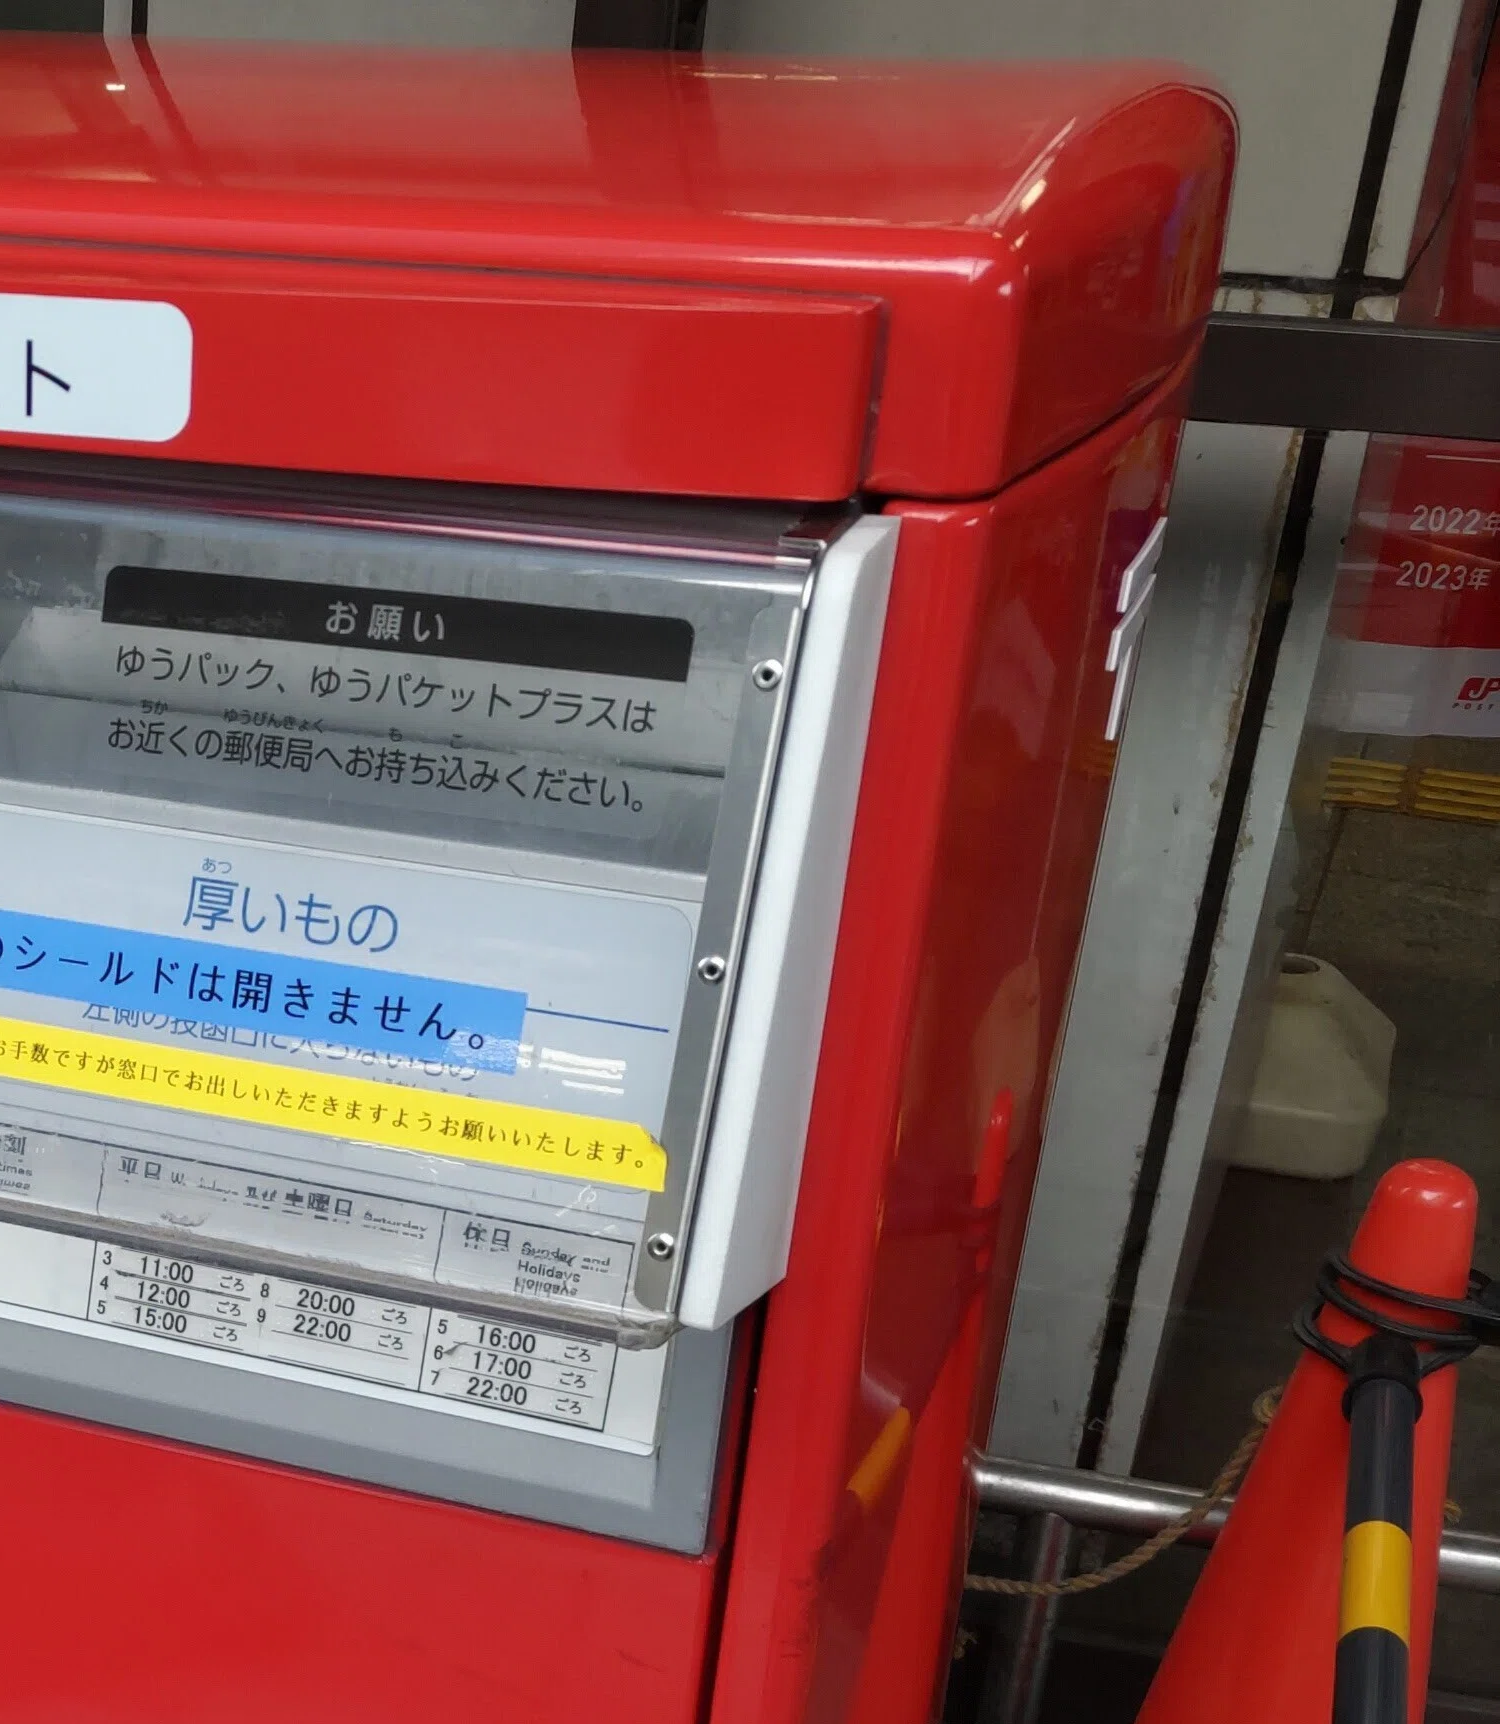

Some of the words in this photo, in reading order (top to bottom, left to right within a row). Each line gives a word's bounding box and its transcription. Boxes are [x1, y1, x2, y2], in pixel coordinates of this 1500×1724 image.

[1395, 561, 1492, 591] 2023年
[325, 600, 446, 645] お願い
[115, 644, 658, 735] ゆうパック、ゆうパケットプラスは
[107, 717, 644, 813] お近くの郵便局へお持ち込みください。
[183, 876, 399, 954] 厚いもの
[102, 1250, 112, 1266] 3
[141, 1256, 194, 1285] 11:00
[99, 1275, 109, 1291] 4
[137, 1280, 191, 1309] 12:00
[260, 1283, 270, 1299] 8
[297, 1288, 355, 1317] 20:00
[96, 1299, 106, 1315] 5
[133, 1305, 188, 1334] 15:00
[257, 1308, 267, 1325] 9
[293, 1314, 351, 1342] 22:00
[437, 1319, 448, 1337] 5
[477, 1325, 536, 1355] 16:00
[433, 1345, 444, 1361] 6
[473, 1351, 532, 1380] 17:00
[429, 1370, 440, 1386] 7
[466, 1376, 527, 1406] 22:00
